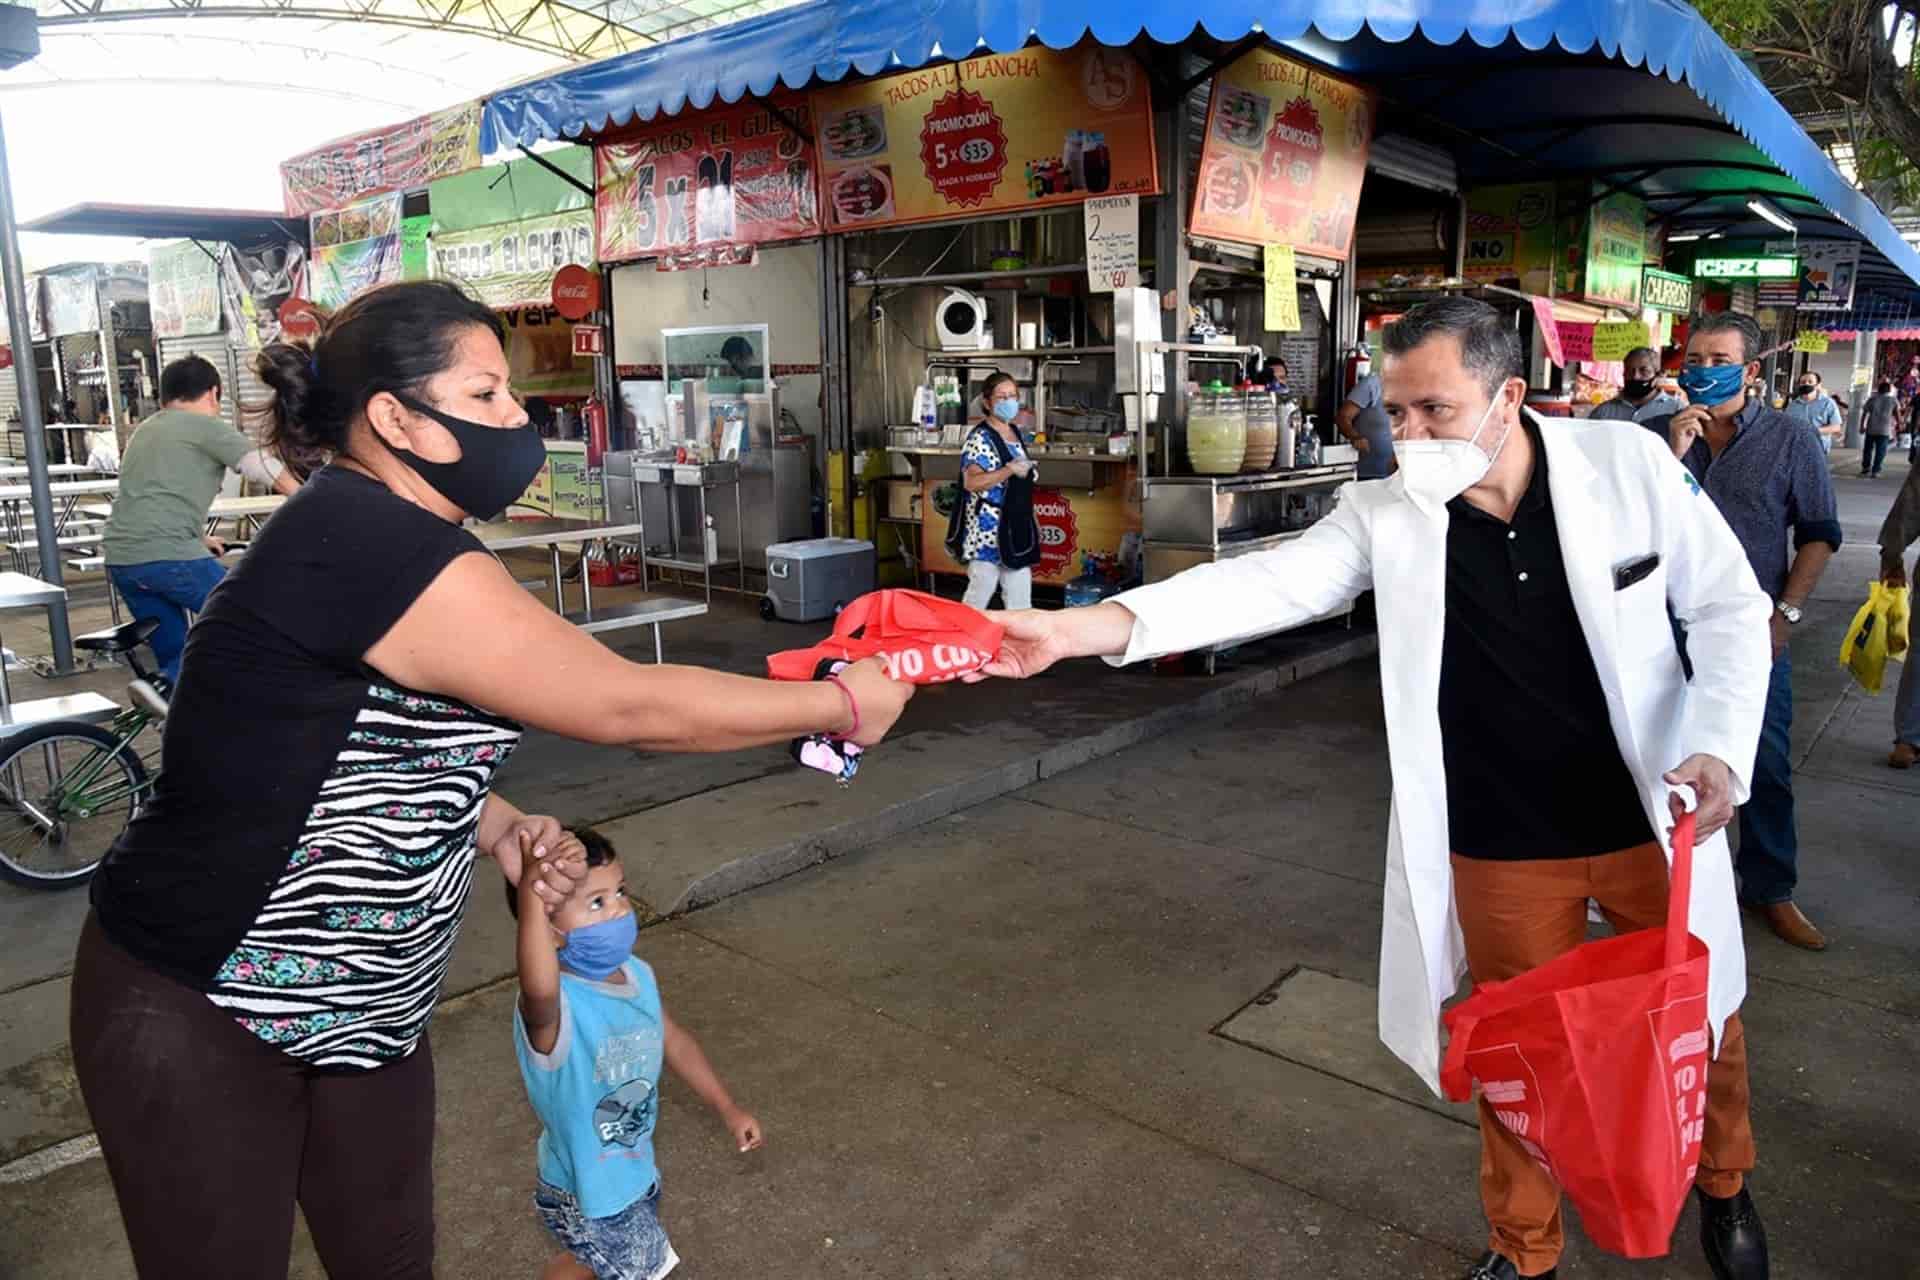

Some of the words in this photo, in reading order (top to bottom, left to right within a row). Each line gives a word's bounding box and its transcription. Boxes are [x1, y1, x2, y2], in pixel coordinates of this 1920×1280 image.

[887, 75, 929, 107] TACOS
[931, 71, 941, 88] A
[966, 57, 1040, 81] PLANCHA
[929, 109, 990, 134] PROMOCIÓN
[935, 143, 948, 169] 5
[963, 142, 989, 161] $35
[1088, 214, 1101, 241] 2
[1647, 276, 1691, 309] CHURROS
[886, 648, 924, 681] YO
[600, 1121, 625, 1142] 23
